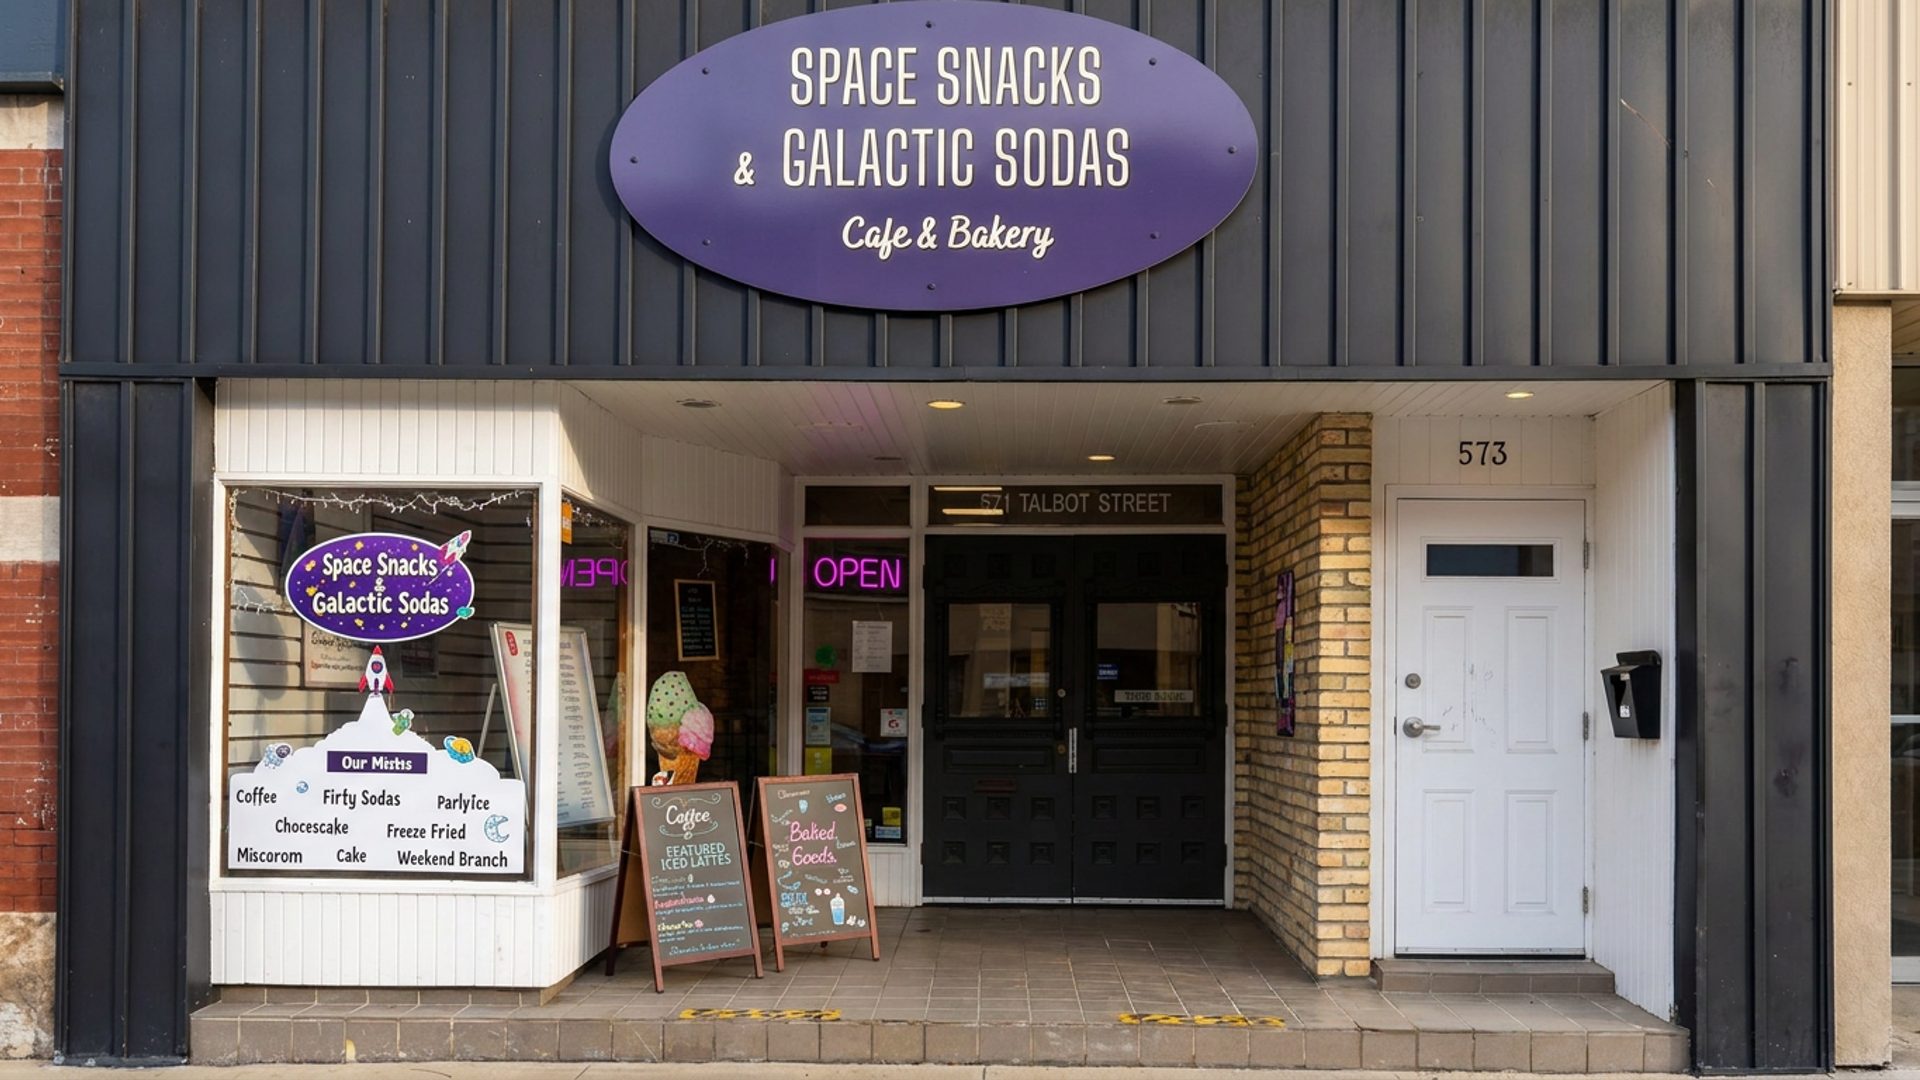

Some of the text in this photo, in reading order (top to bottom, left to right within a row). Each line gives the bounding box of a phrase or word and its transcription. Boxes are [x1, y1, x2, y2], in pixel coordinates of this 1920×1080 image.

[791, 46, 1101, 106] SPACE SNACKS
[734, 128, 1130, 187] & GALACTIC SODAS
[842, 215, 1054, 260] Cafe & Bakery
[1458, 441, 1508, 466] 573
[1019, 493, 1090, 513] TALBOT
[1099, 493, 1171, 513] STREET
[322, 552, 438, 581] Space Snacks
[814, 557, 900, 588] OPEN
[312, 591, 449, 615] Galactic Sodas
[341, 755, 368, 770] Our
[236, 786, 277, 806] Coffee
[361, 790, 401, 806] Sodas
[387, 823, 466, 839] Freeze Fried
[336, 846, 367, 863] Cake
[397, 849, 508, 867] Weekend Branch
[661, 853, 731, 871] ICED LATTES
